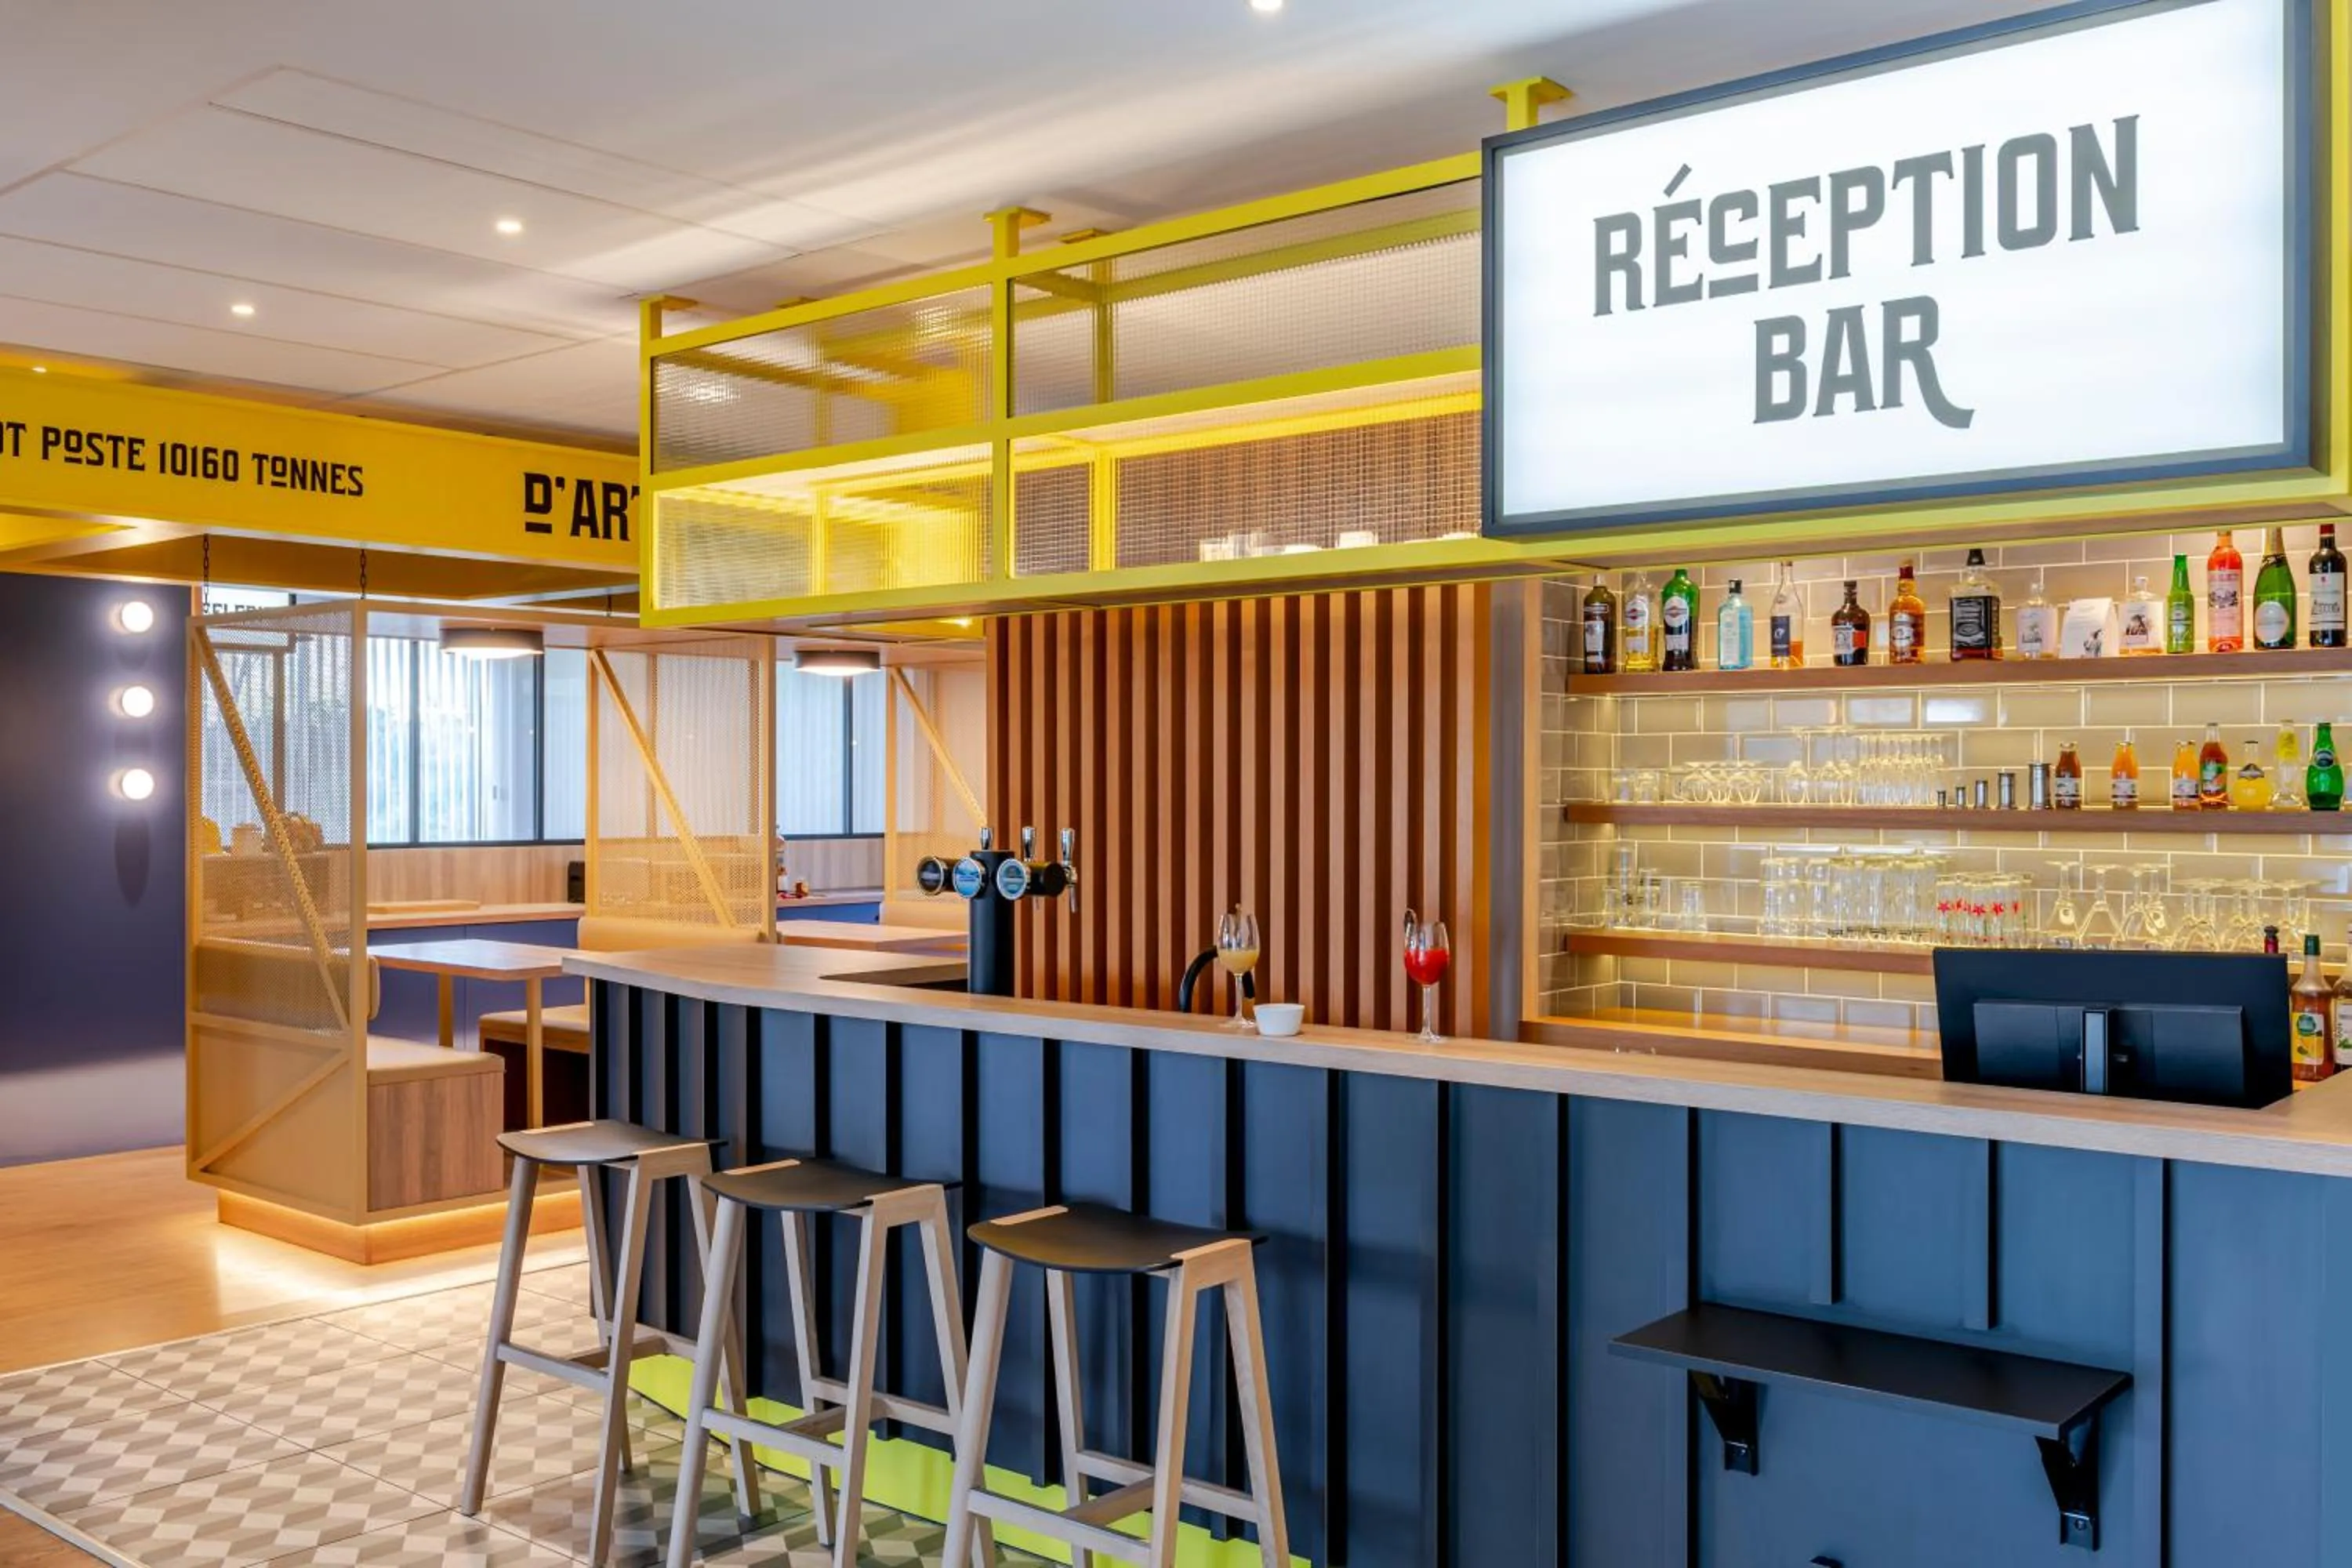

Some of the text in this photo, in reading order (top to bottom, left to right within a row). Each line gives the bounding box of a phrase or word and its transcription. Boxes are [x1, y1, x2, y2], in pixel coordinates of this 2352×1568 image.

[1592, 114, 2140, 318] RÉCEPTION
[1752, 295, 1975, 429] BAR
[0, 420, 364, 497] T POSTE 10160 TONNES
